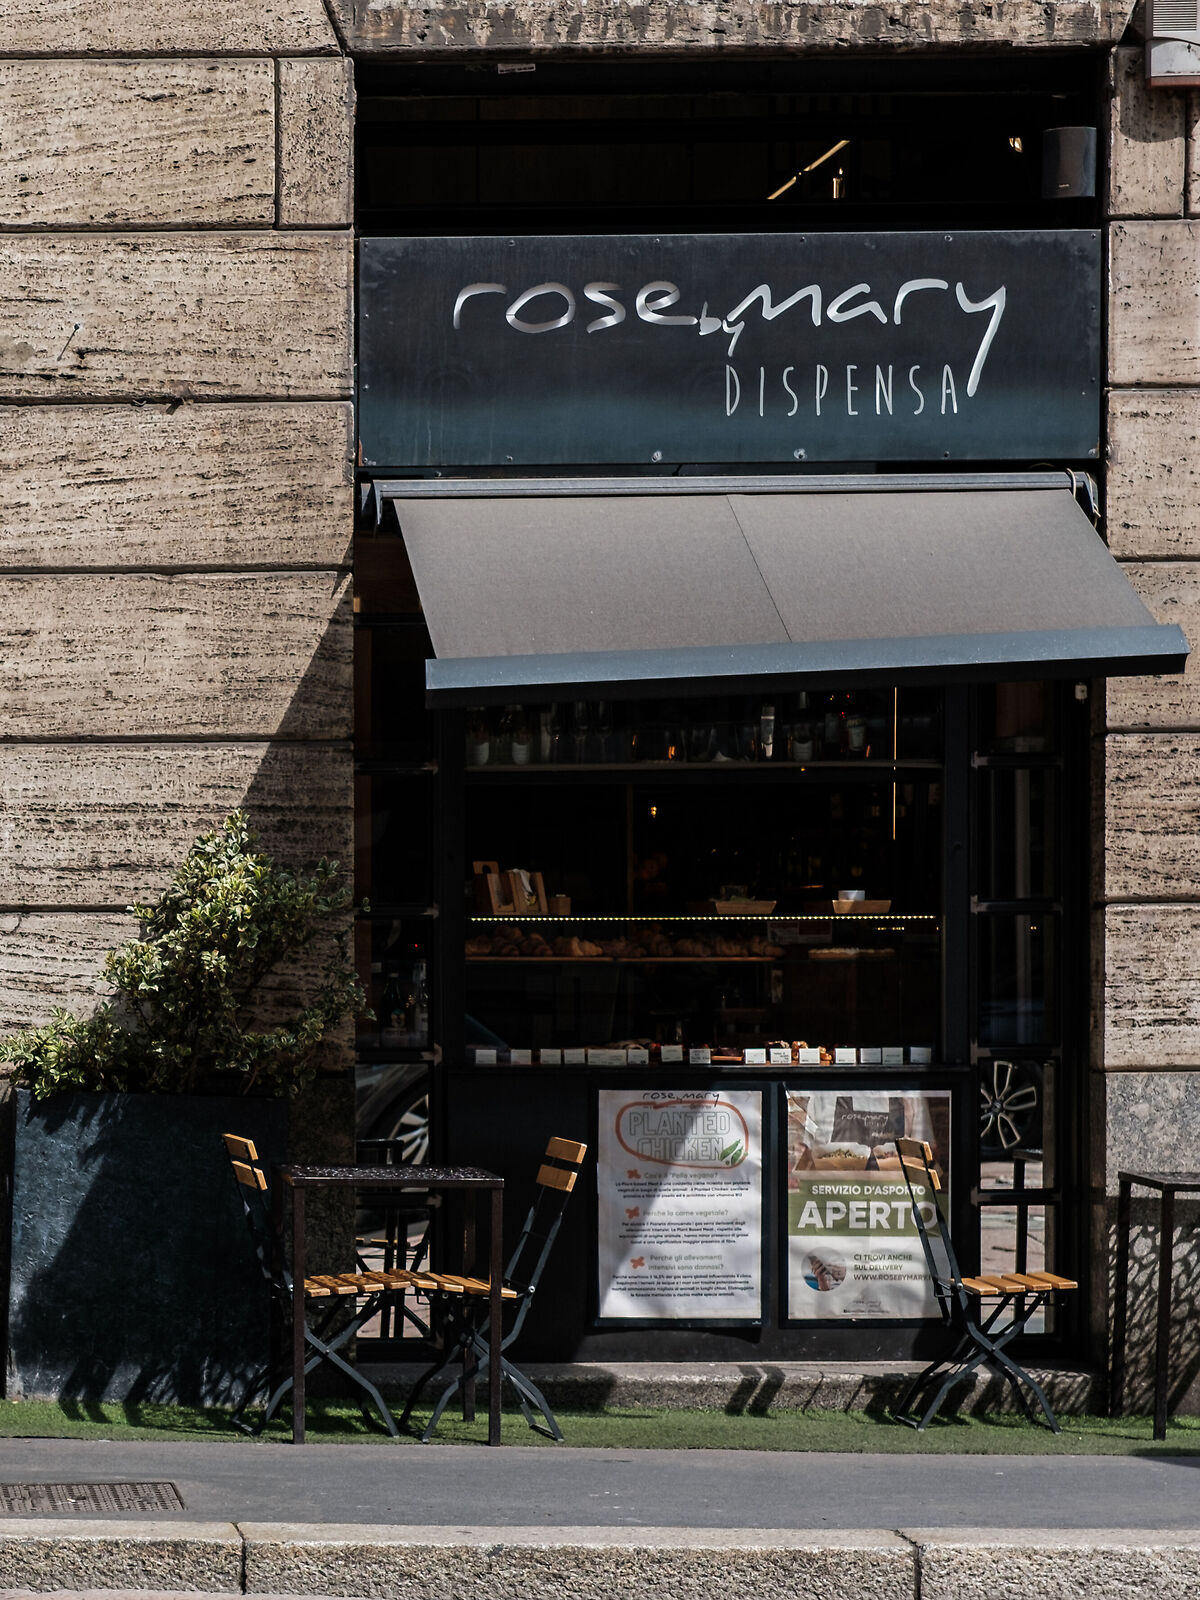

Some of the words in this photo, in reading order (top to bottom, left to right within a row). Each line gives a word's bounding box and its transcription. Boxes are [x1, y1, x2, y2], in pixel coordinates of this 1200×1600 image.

[725, 364, 958, 417] DISPENSA
[629, 1111, 730, 1136] PLANTED
[637, 1137, 724, 1161] CHICKEN
[812, 1185, 861, 1195] SERVIZIO
[797, 1200, 938, 1230] APERTO
